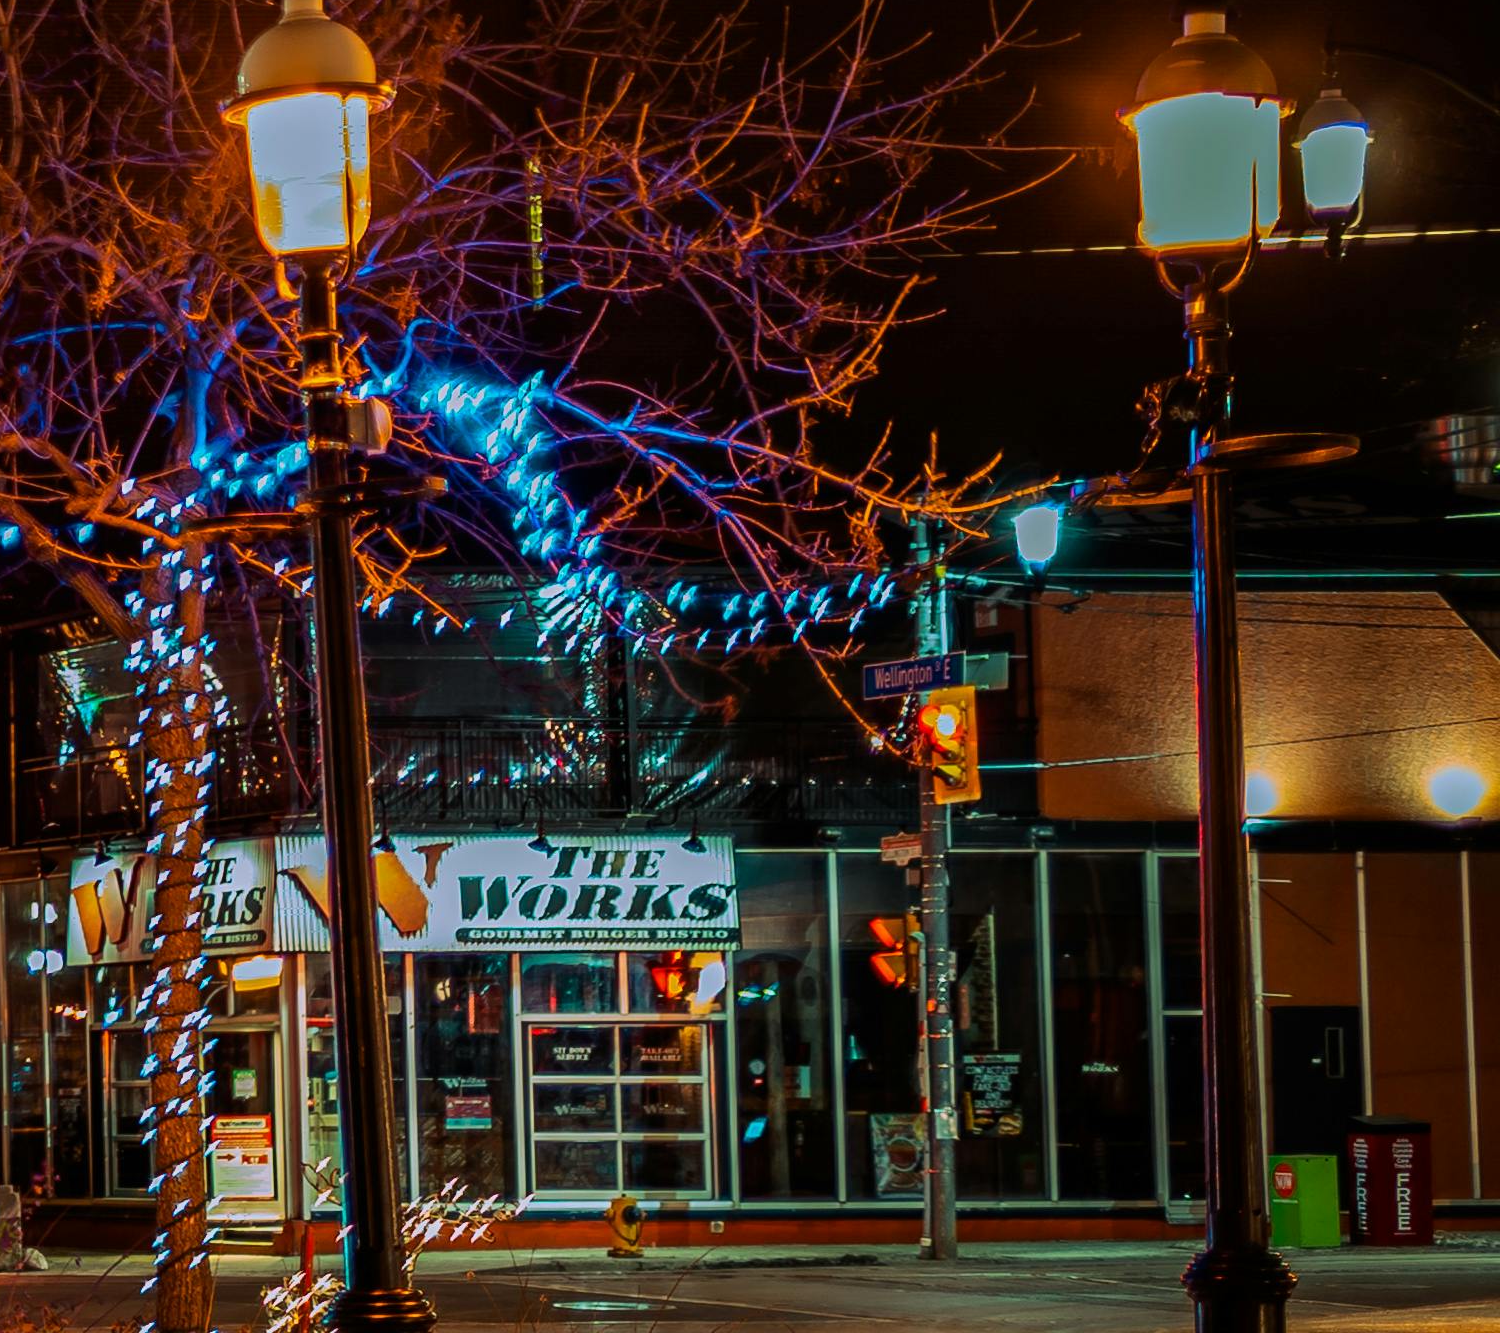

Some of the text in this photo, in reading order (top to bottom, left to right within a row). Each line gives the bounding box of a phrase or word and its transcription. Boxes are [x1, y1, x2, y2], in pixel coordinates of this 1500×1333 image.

[874, 664, 933, 691] Wellington
[943, 658, 951, 681] E
[200, 857, 238, 888] HE
[548, 846, 667, 879] THE
[199, 885, 267, 930] RKS
[457, 874, 737, 922] WORKS
[468, 929, 730, 940] GOURMET BURGER BISTRO
[1355, 1172, 1369, 1231] FREE
[1395, 1172, 1413, 1231] FREE
